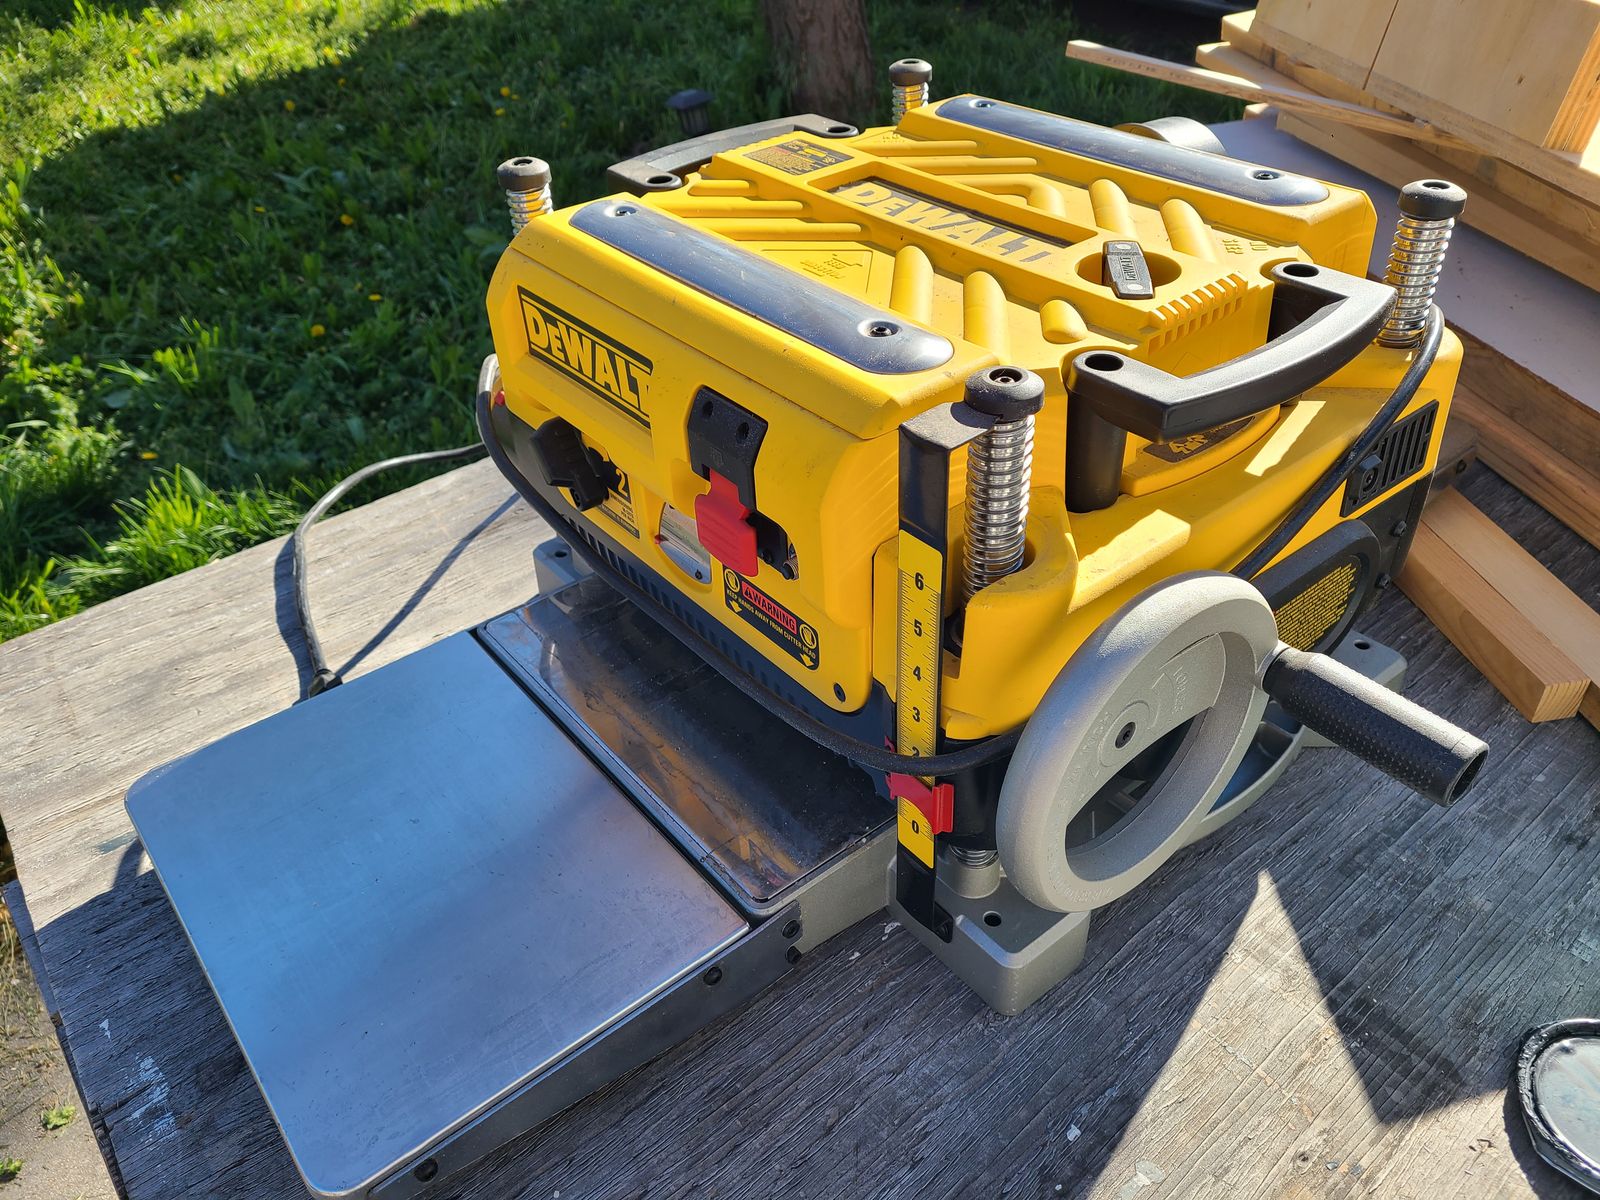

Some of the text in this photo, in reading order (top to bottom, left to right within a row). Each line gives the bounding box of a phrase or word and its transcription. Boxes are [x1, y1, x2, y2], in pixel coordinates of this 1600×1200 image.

[615, 468, 628, 498] 2
[914, 572, 925, 591] 6
[751, 591, 796, 631] WARNING
[726, 589, 817, 660] KEEP HANDS AWAY FROM CUTTER HEAD
[913, 619, 923, 638] 5
[912, 665, 922, 682] 4
[912, 706, 921, 723] 3
[911, 820, 920, 835] 0
